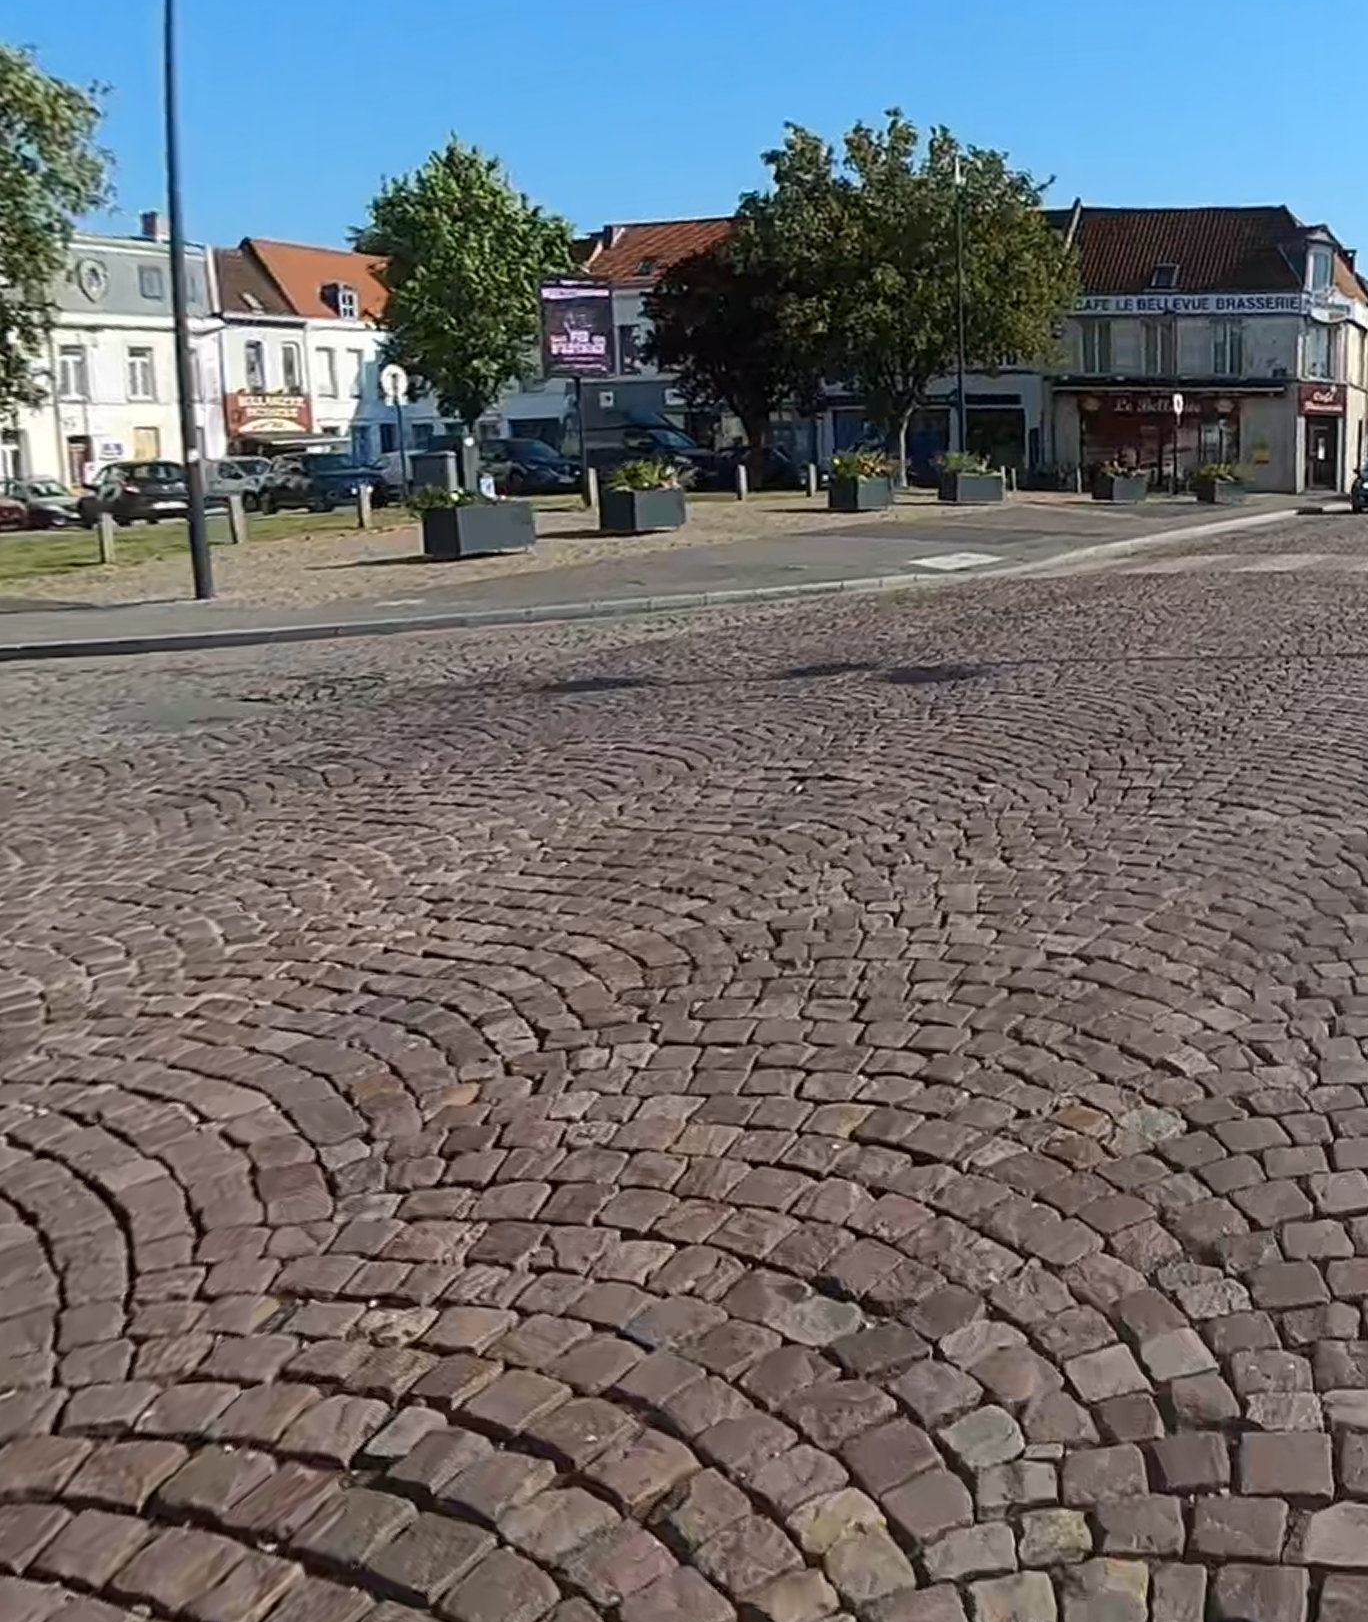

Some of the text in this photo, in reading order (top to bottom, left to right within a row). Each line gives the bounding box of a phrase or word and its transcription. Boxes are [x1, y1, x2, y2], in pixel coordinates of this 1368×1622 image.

[1115, 298, 1134, 311] LE
[1136, 298, 1210, 311] BELLEVUE
[1215, 296, 1299, 310] BRASSERIE
